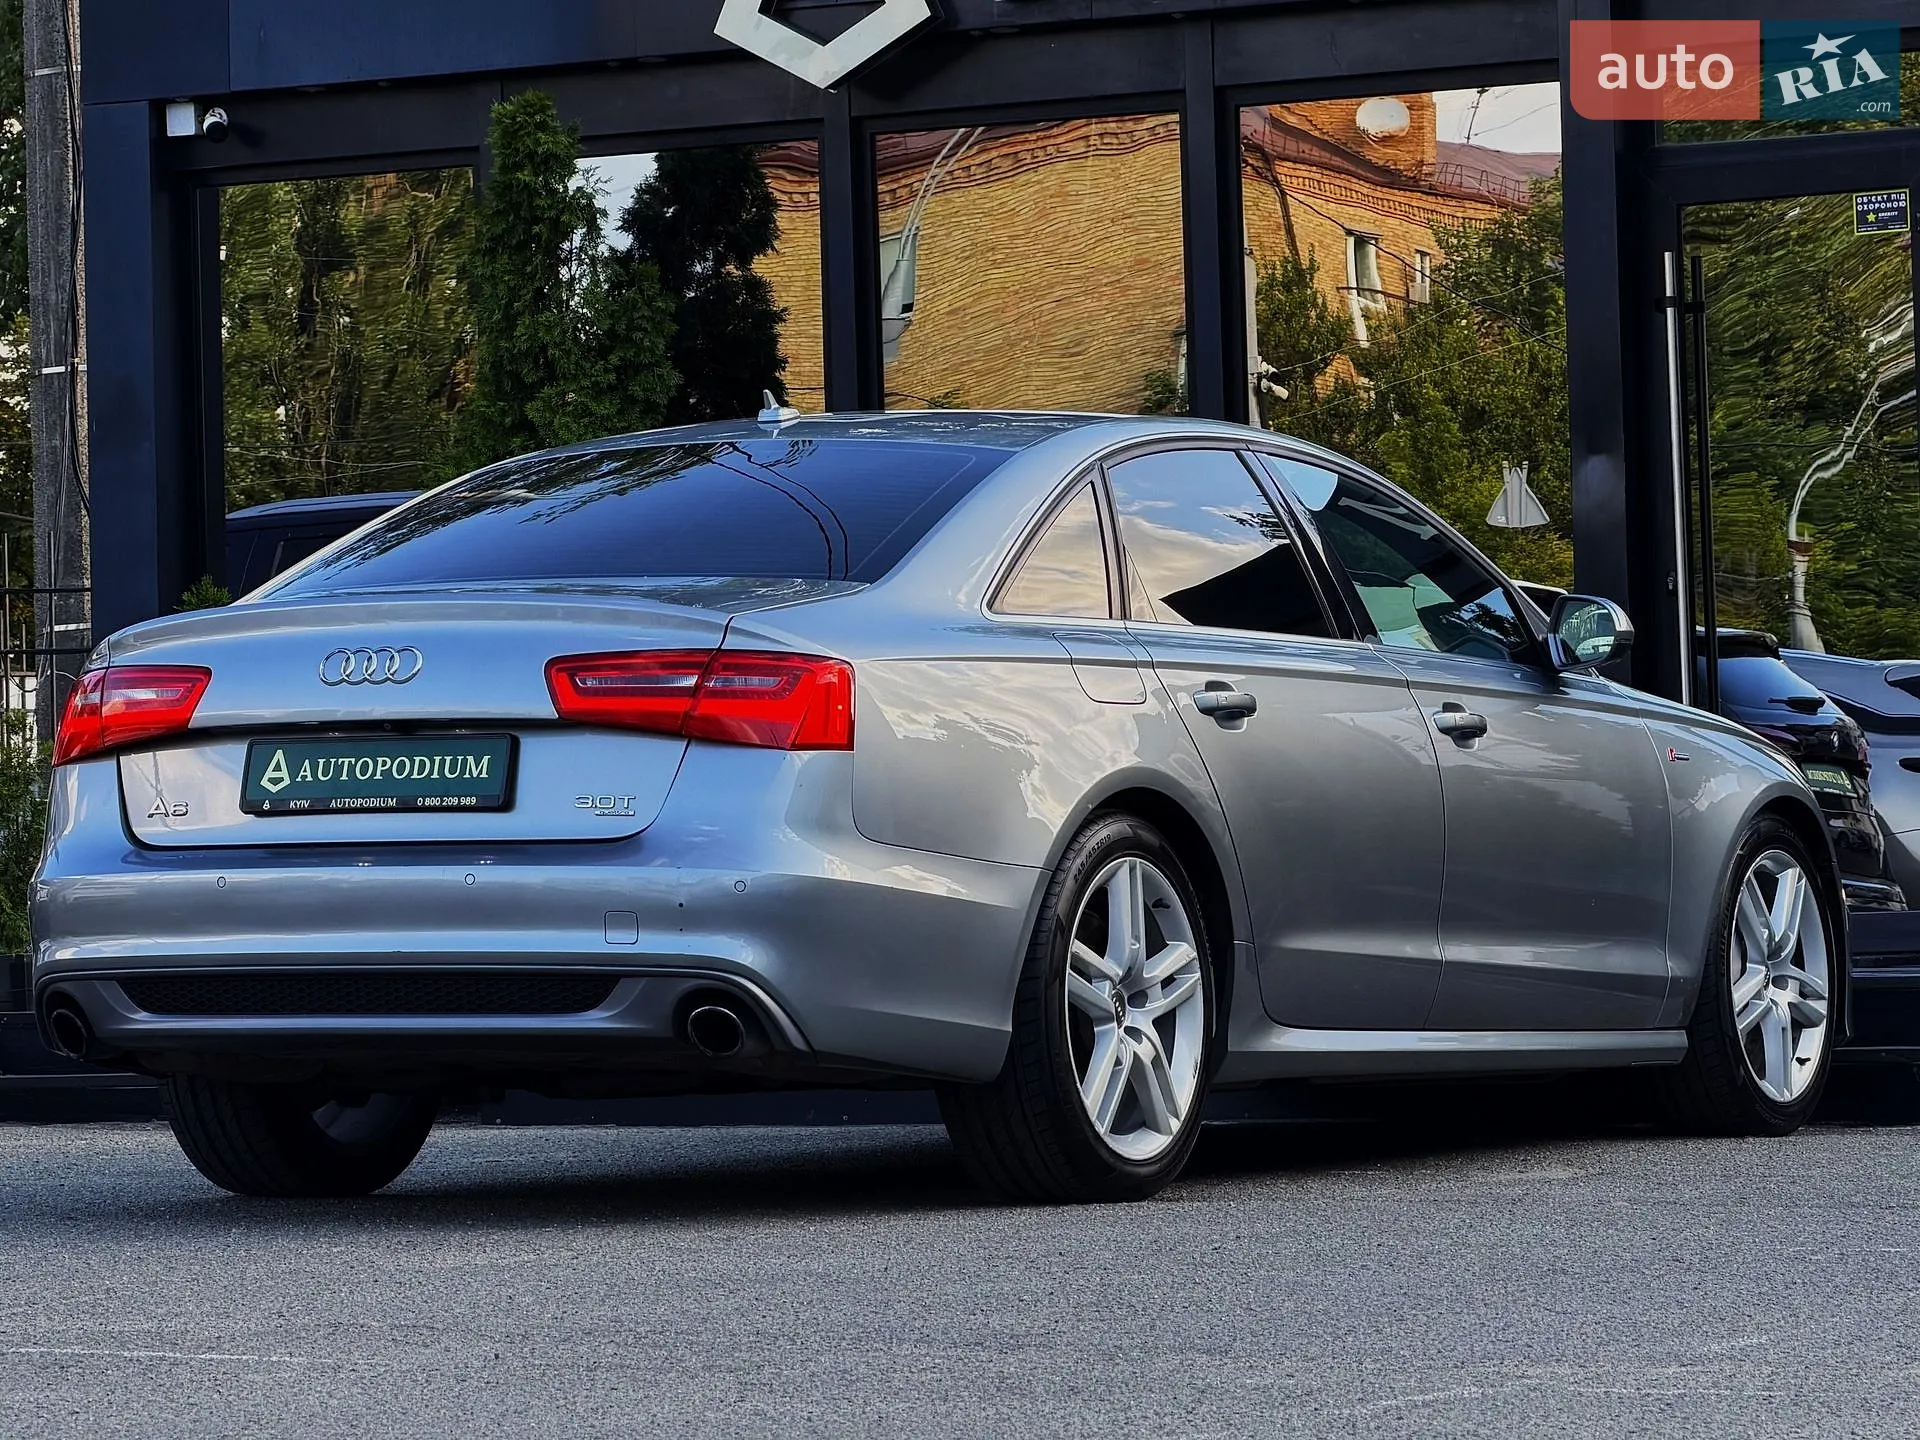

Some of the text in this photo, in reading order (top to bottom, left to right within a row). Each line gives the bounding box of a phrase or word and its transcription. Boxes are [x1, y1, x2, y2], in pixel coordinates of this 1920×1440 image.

[1857, 201, 1907, 211] ОХОРОНОЮ
[296, 754, 492, 782] AUTOPODIUM
[146, 796, 189, 819] A6
[289, 796, 477, 809] KYIV AUTOPODIUM 0 800 209 989
